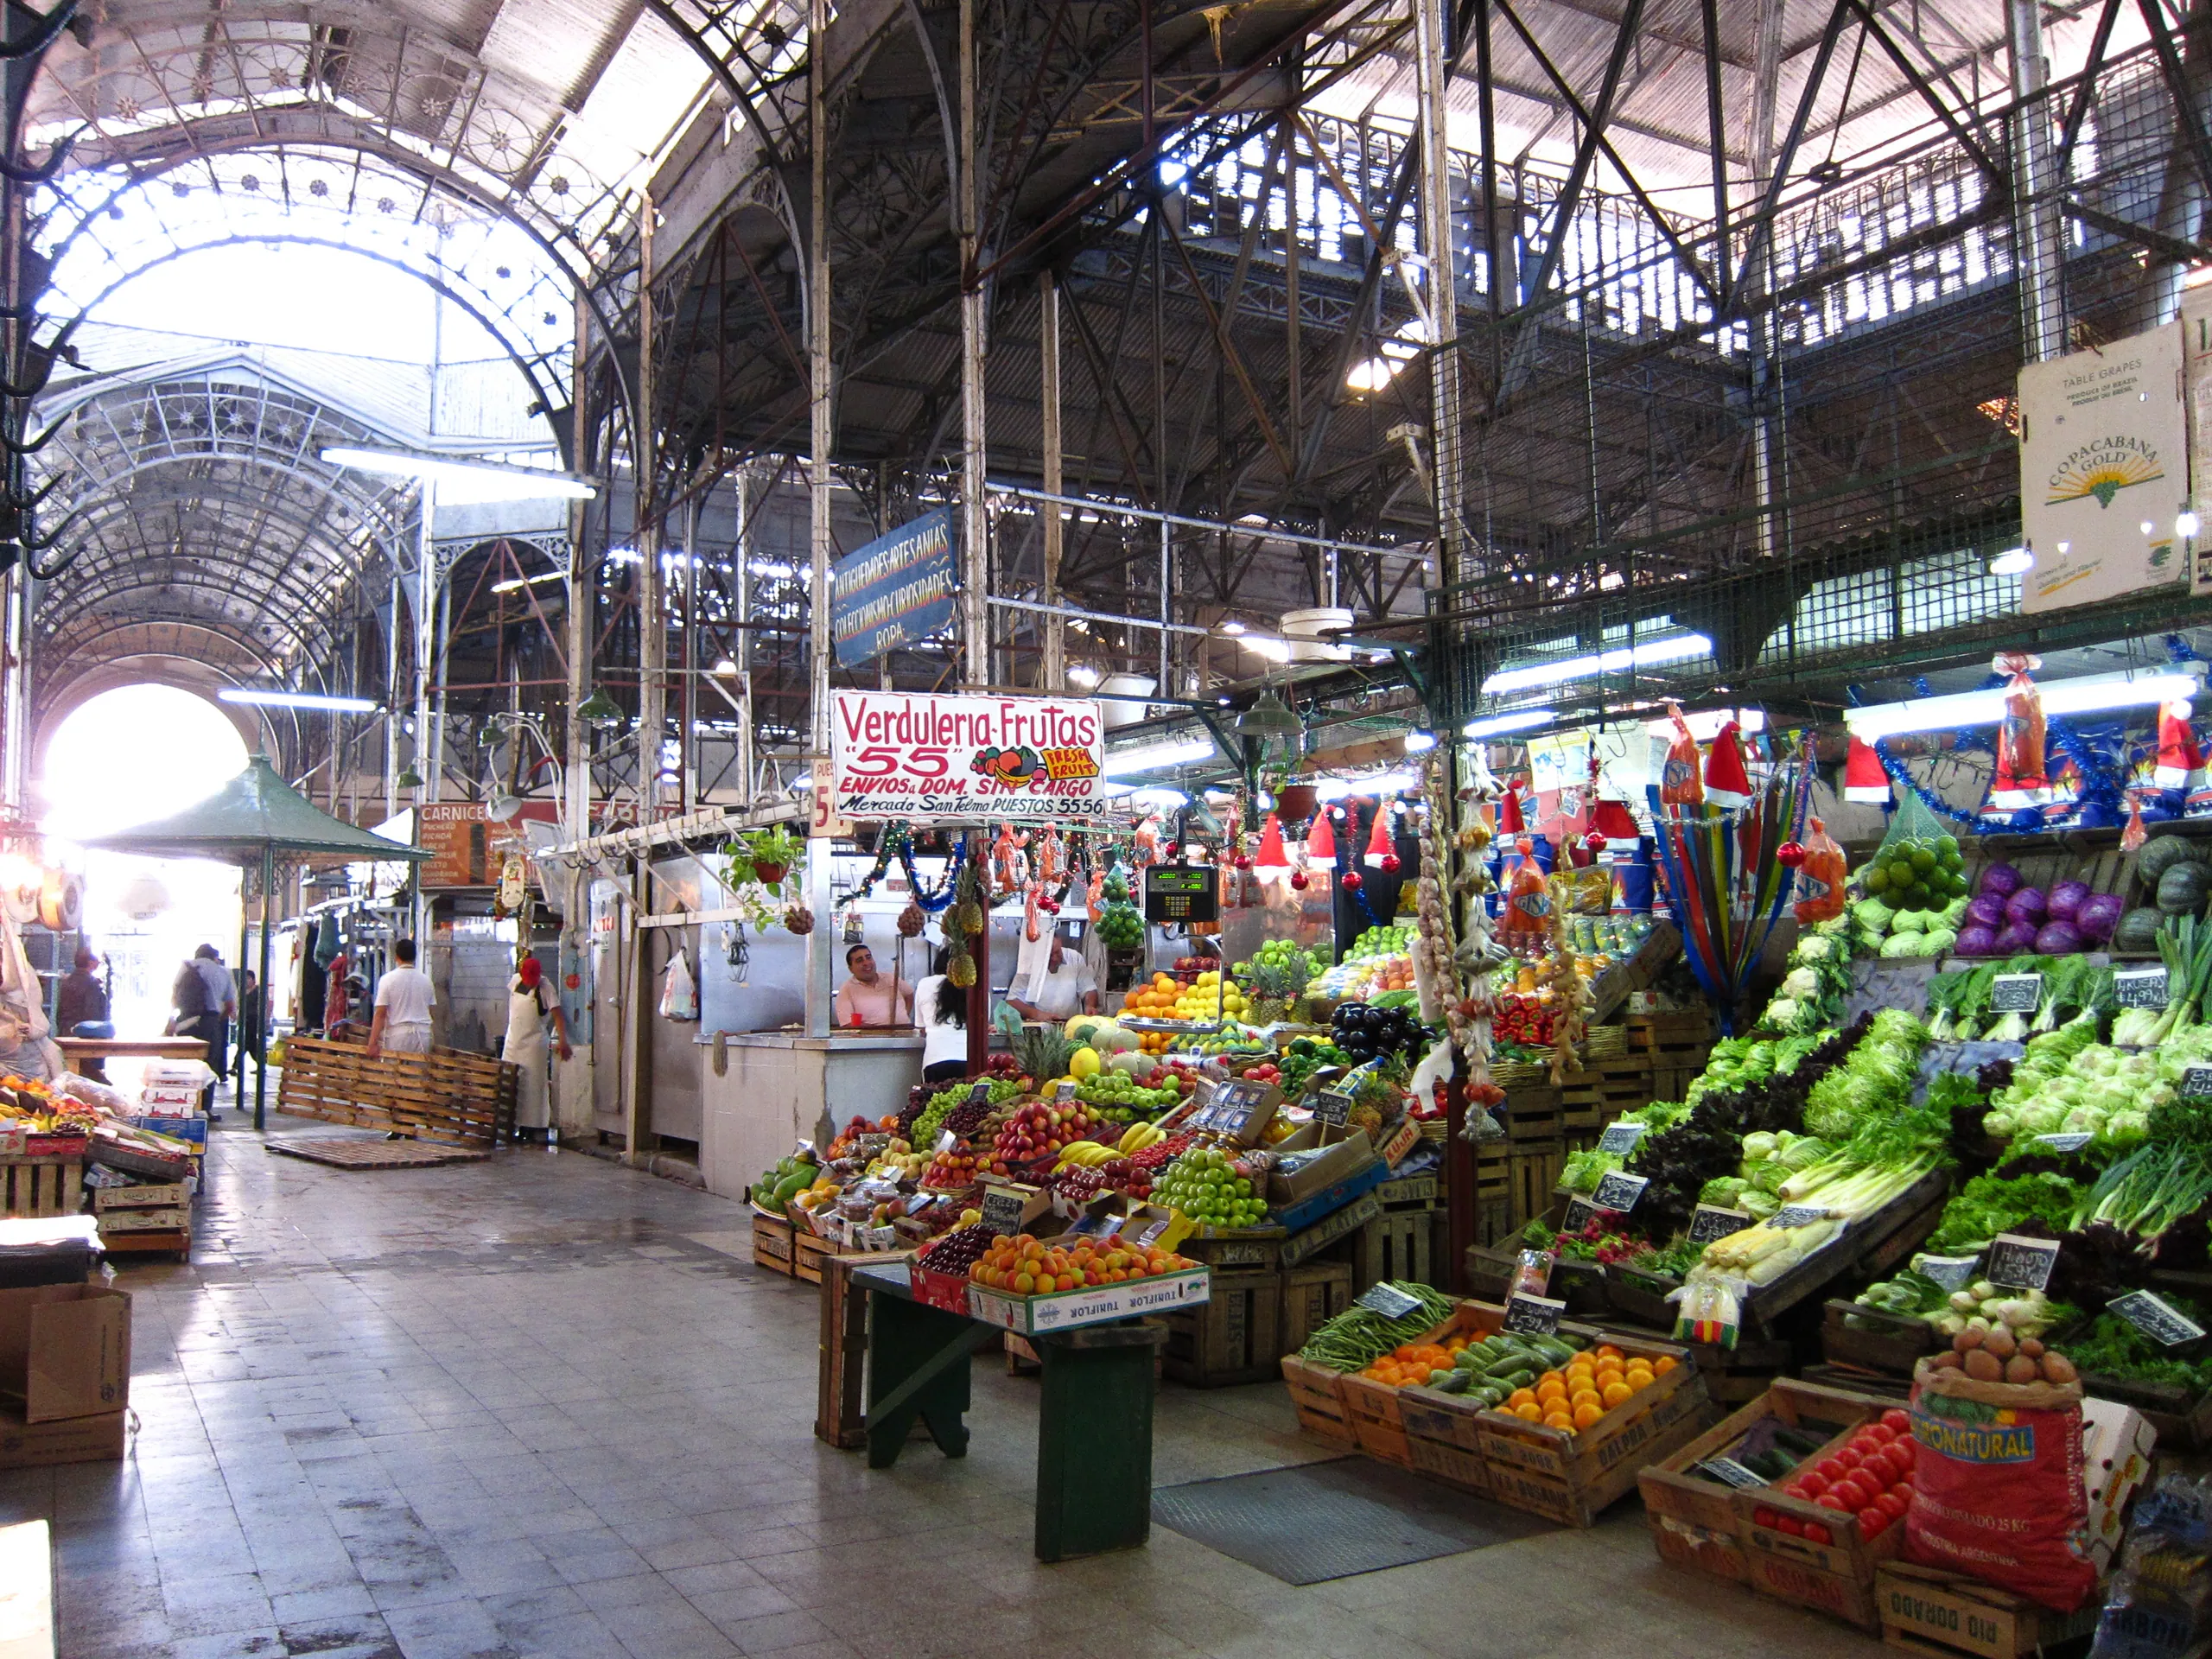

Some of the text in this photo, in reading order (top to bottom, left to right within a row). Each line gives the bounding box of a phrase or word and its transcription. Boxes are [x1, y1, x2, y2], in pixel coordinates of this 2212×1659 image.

[2063, 359, 2142, 388] TABLE GRAPES
[2049, 435, 2158, 487] COPACABANA
[2080, 453, 2126, 473] GOLD
[1046, 748, 1090, 767] FRESH
[1053, 763, 1094, 779] FRUIT
[838, 777, 908, 793] ENVIOS
[918, 777, 968, 796] DOM.
[976, 779, 1020, 796] SIN
[1028, 779, 1093, 796] CARGO
[839, 795, 915, 813] Mercado
[992, 798, 1054, 815] PUESTOS
[1070, 1291, 1178, 1319] TUNIFLOR TUNIFLOR
